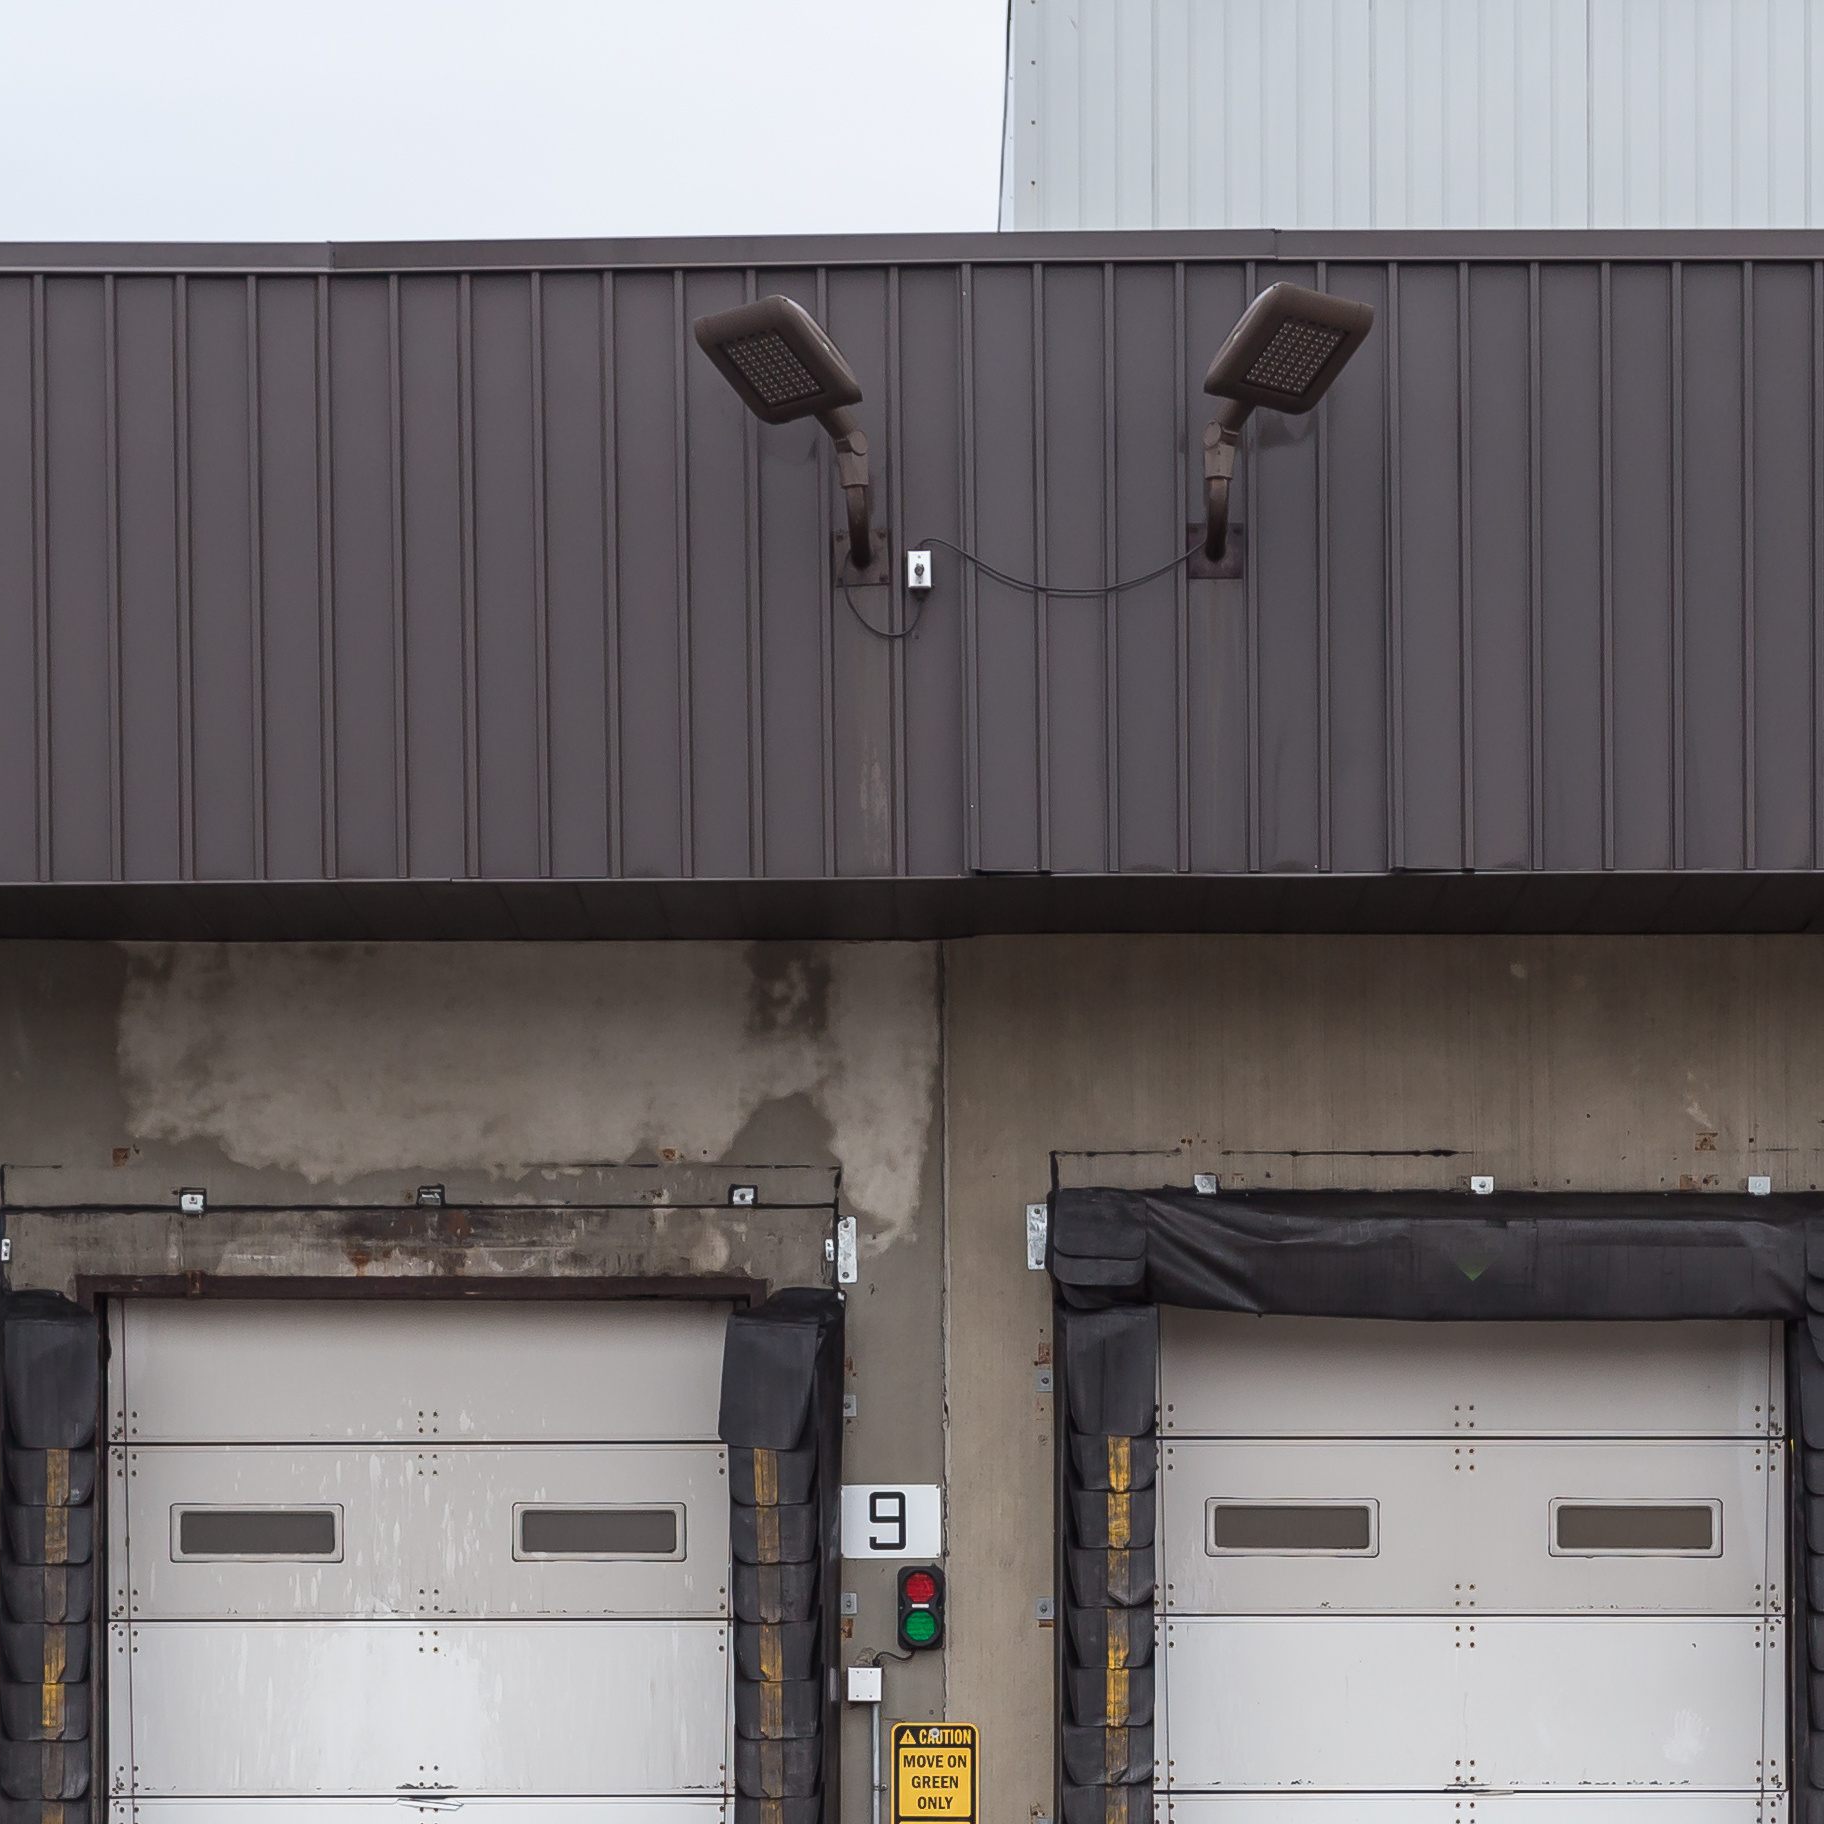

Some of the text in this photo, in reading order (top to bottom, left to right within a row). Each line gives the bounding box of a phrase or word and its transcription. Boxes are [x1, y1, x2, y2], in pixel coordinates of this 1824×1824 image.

[870, 1492, 906, 1550] 9
[904, 1755, 966, 1768] MOVE ON
[912, 1776, 958, 1788] GREEN
[918, 1797, 953, 1809] ONLY
